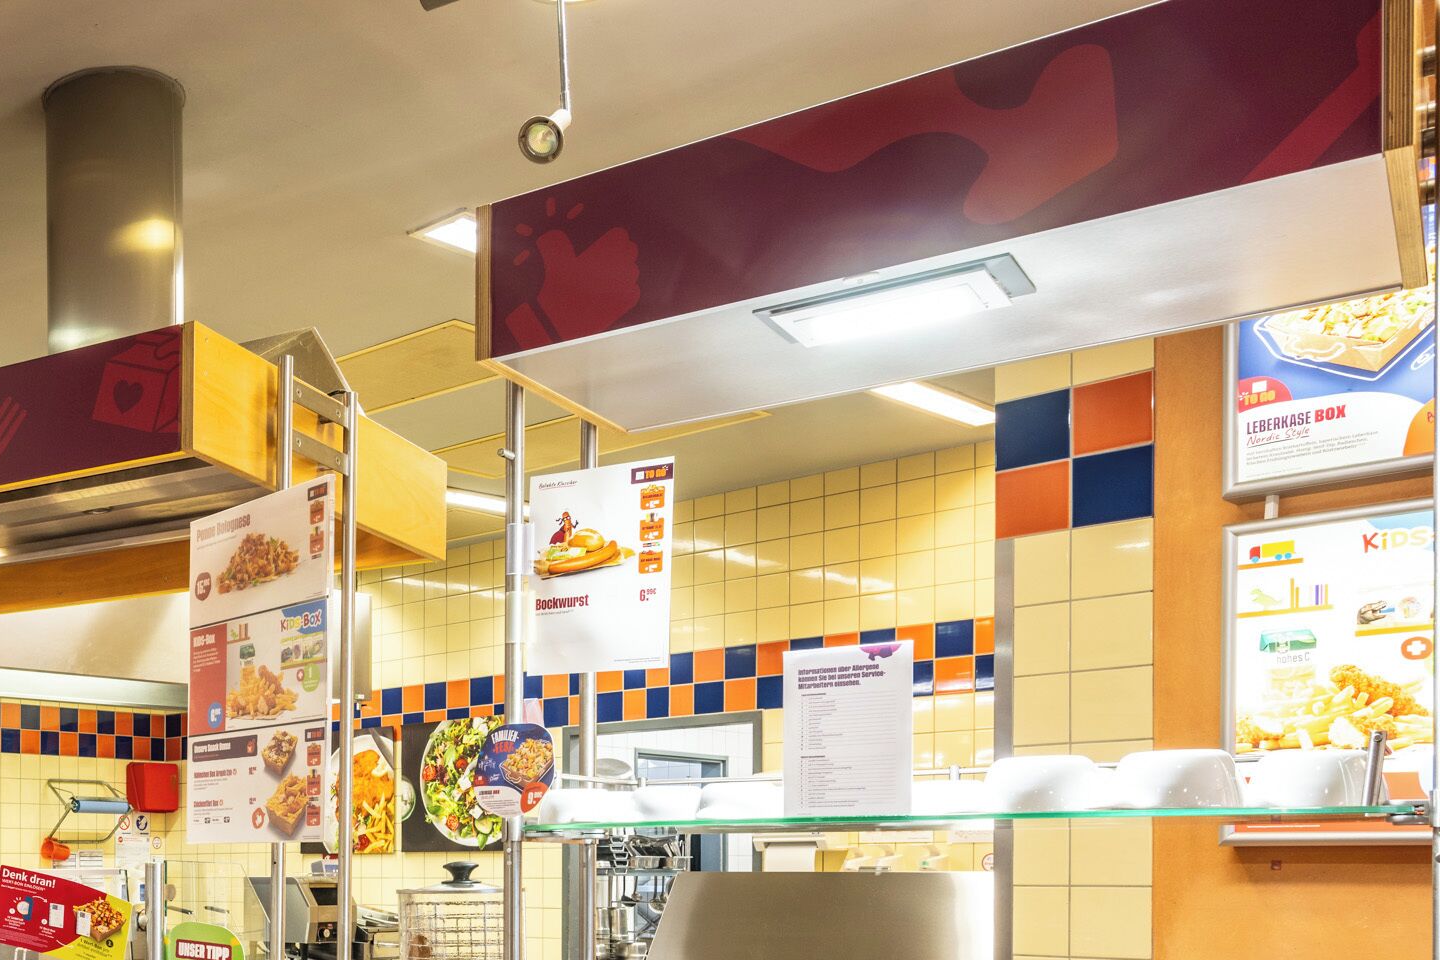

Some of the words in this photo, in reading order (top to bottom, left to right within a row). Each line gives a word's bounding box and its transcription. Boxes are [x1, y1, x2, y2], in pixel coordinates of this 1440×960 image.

[1315, 405, 1347, 423] BOX
[1247, 434, 1280, 446] Nordic
[1286, 426, 1310, 438] Style
[536, 594, 589, 611] Bockwurst
[491, 730, 520, 744] FAMILIEN-
[2, 868, 28, 882] Denk
[30, 875, 56, 889] dran!
[178, 942, 206, 959] UNSER
